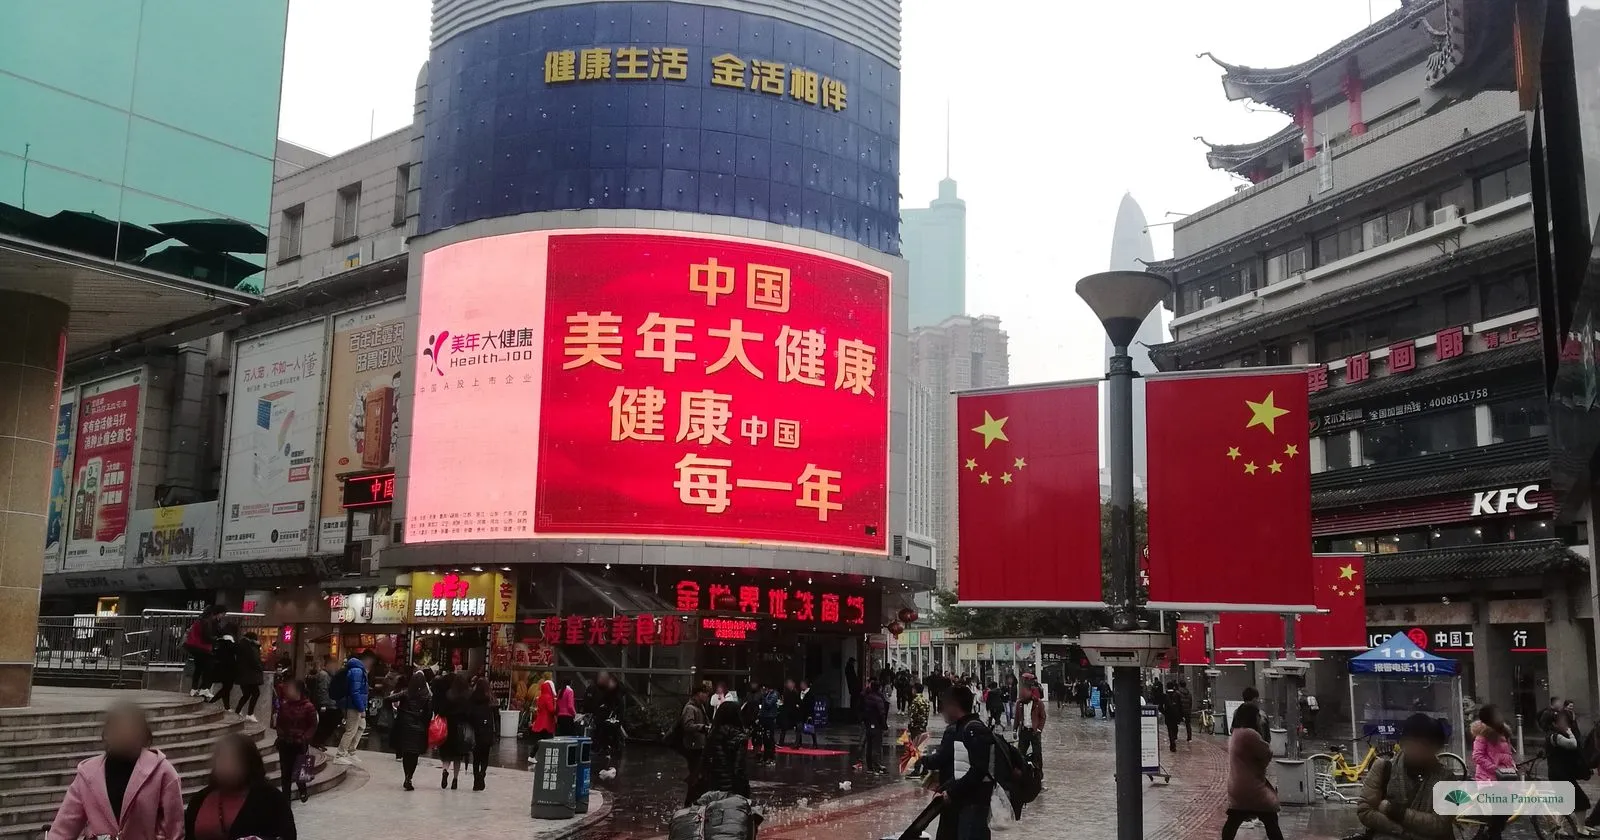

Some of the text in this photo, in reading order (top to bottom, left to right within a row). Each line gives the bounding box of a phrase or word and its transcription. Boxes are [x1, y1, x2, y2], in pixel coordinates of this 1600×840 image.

[544, 47, 848, 111] 健康生活 金活相伴
[689, 257, 791, 313] 中国
[451, 327, 533, 354] 美年大健康
[562, 310, 876, 398] 美年大健康
[371, 478, 395, 500] 中国
[673, 453, 843, 522] 每一年
[1470, 485, 1539, 516] KFC
[140, 527, 195, 561] FASHION
[414, 599, 447, 616] 黑色经典
[1381, 647, 1426, 659] 110
